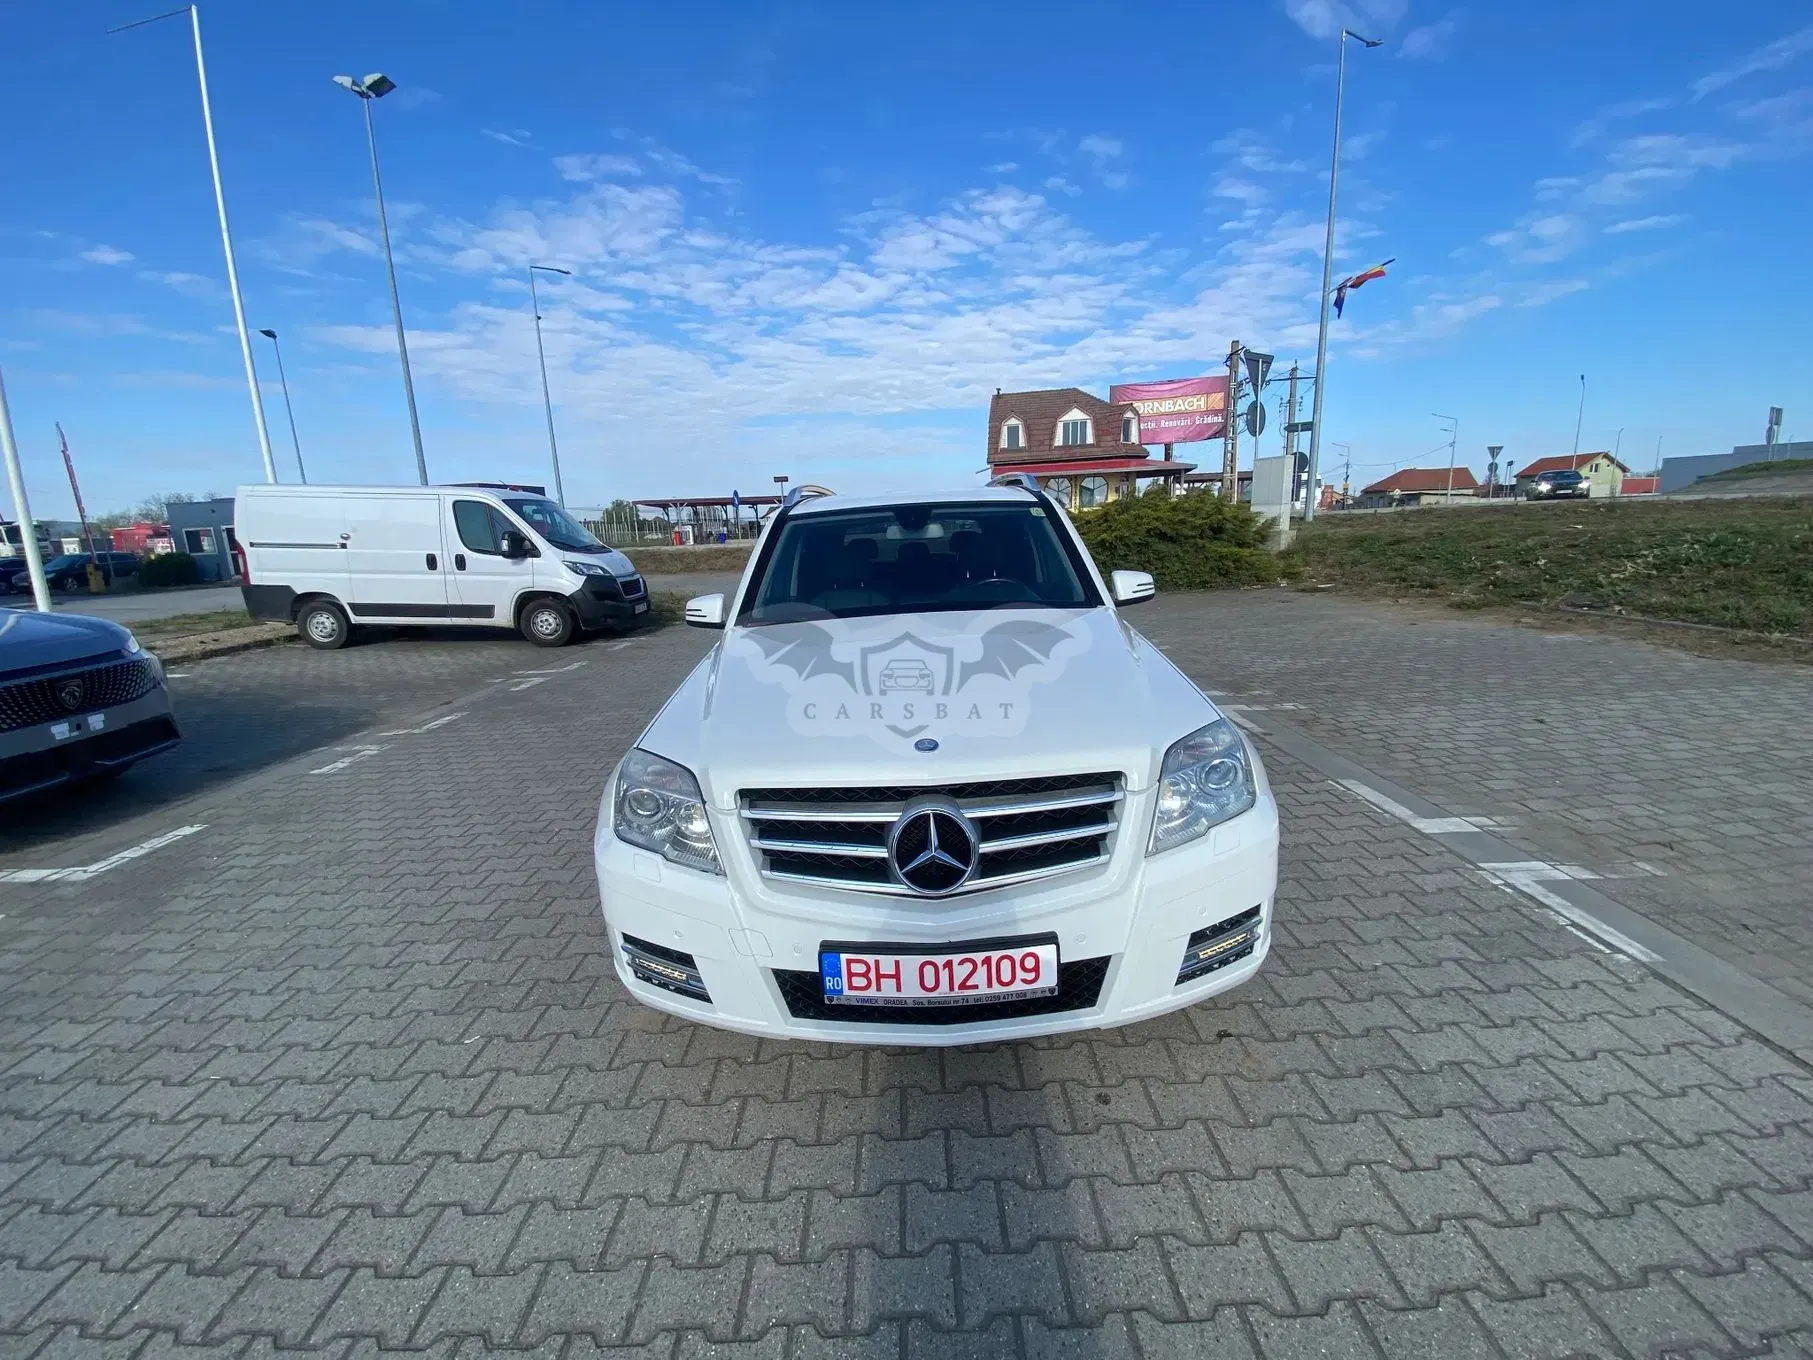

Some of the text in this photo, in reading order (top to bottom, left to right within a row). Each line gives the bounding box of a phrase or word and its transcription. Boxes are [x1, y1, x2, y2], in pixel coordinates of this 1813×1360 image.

[1134, 395, 1205, 414] ORNBACH
[845, 951, 1041, 993] BH 012109
[825, 976, 842, 991] RO
[855, 997, 880, 1005] VIMEX
[883, 998, 908, 1006] ORADEA
